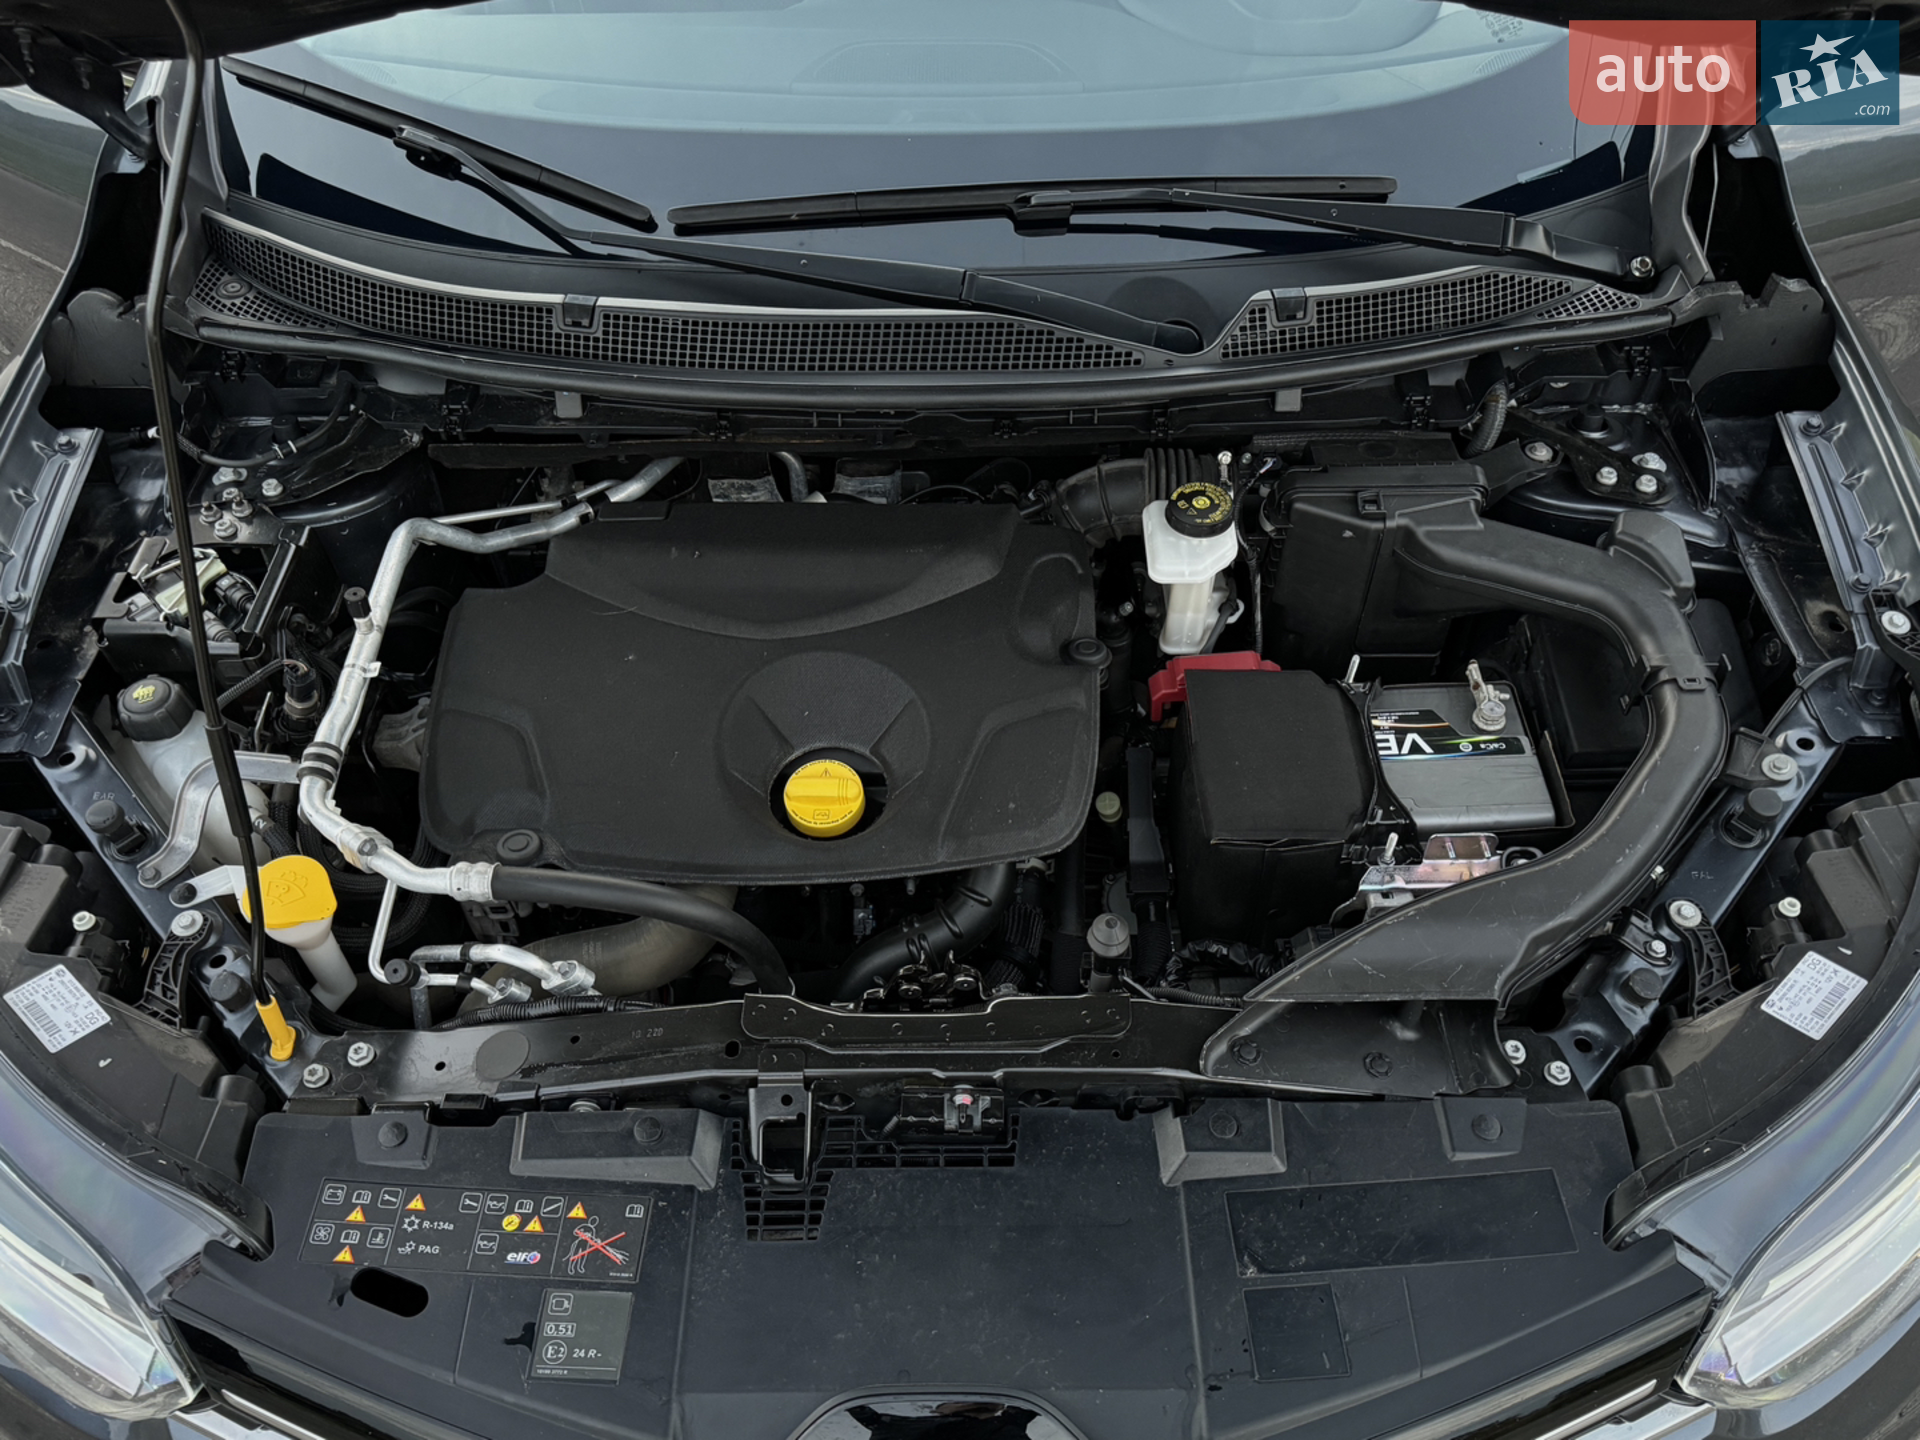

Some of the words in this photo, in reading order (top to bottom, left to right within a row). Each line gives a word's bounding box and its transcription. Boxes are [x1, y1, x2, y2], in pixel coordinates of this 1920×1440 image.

[422, 1220, 454, 1231] R-134a
[418, 1244, 440, 1254] PAG
[506, 1252, 529, 1262] elf
[547, 1324, 573, 1336] 0,51
[546, 1345, 565, 1359] E2
[572, 1348, 585, 1358] 24
